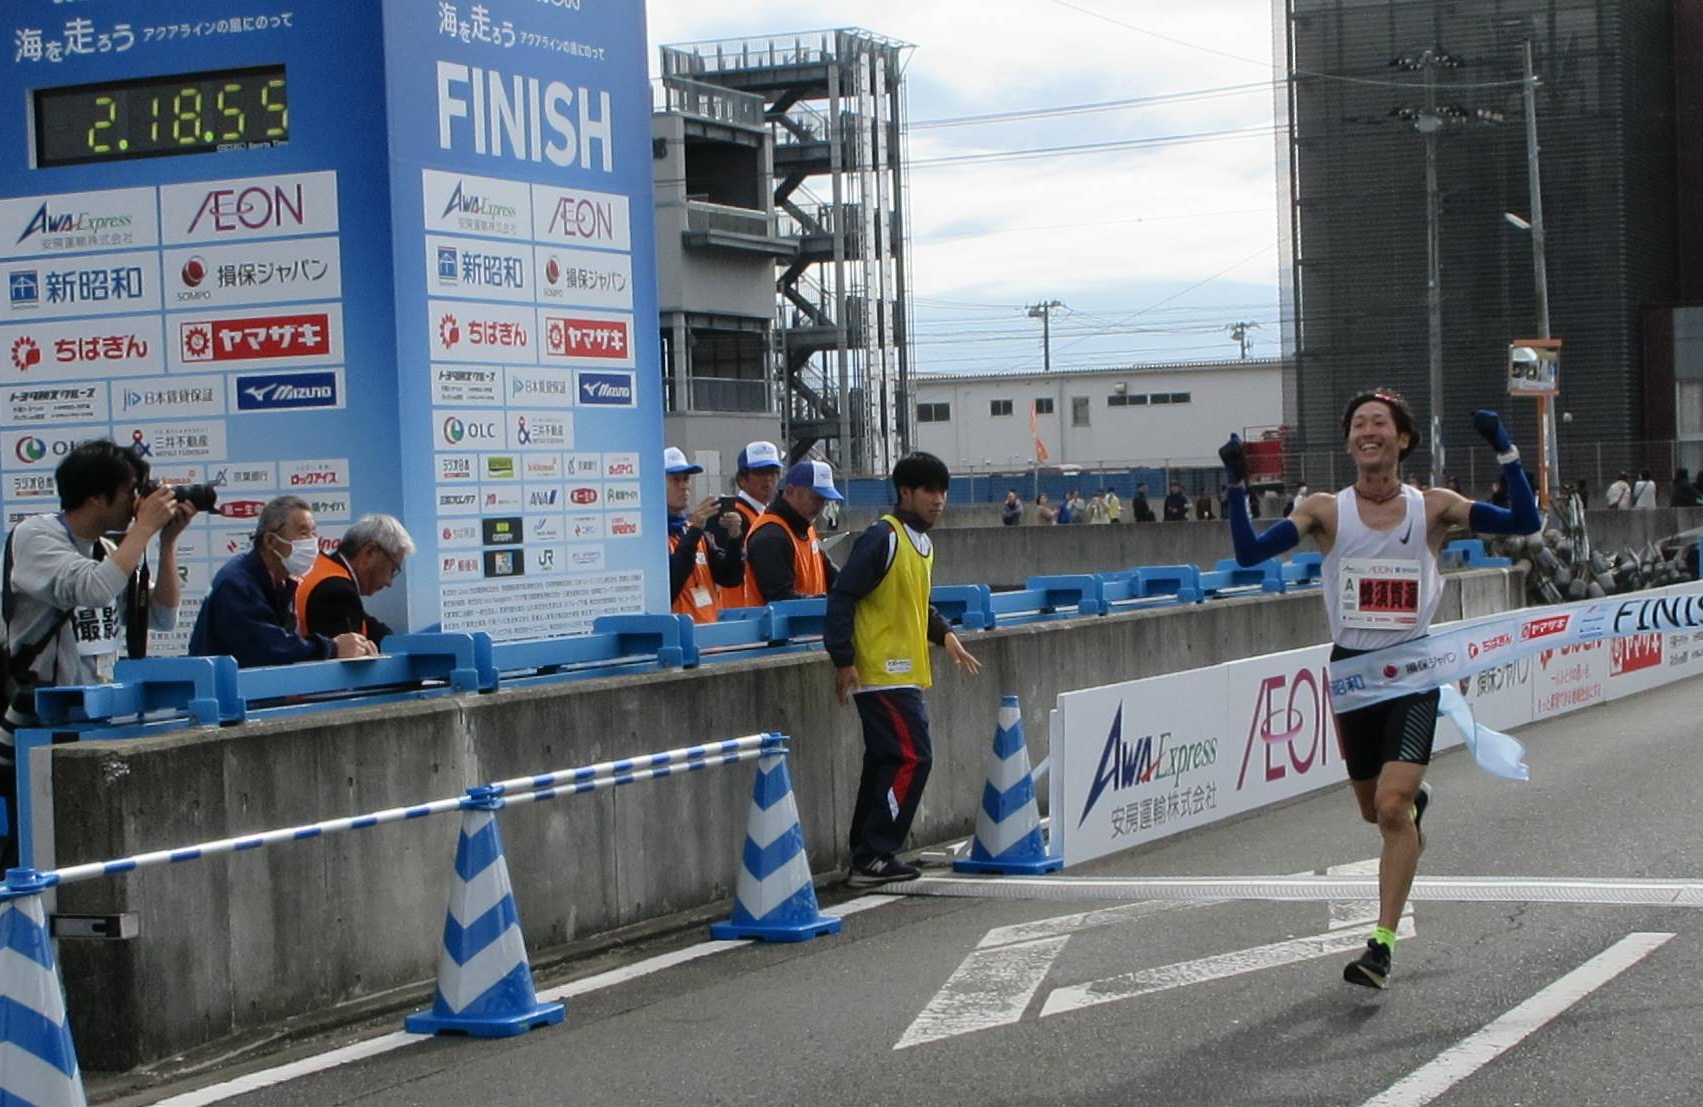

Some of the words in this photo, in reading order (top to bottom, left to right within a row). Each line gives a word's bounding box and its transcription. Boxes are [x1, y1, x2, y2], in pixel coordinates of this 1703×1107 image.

[15, 18, 135, 62] 海を走ろう
[143, 13, 293, 42] アクアラインの風にのって
[438, 1, 516, 48] 海を走ろう
[436, 60, 613, 173] FINISH
[218, 259, 328, 288] 損保ジャパン
[462, 251, 524, 288] 新昭和
[566, 267, 627, 292] 損保ジャパン
[46, 267, 143, 304] 新昭和
[218, 323, 322, 352] ヤマザキ
[467, 320, 528, 347] ちばぎん
[567, 326, 625, 350] ヤマザキ
[54, 334, 148, 362] ちばぎん
[468, 422, 495, 439] OLC
[291, 471, 338, 486] ロックアイス
[530, 491, 549, 506] ANA
[539, 549, 554, 566] JR
[1344, 577, 1355, 592] A
[1532, 617, 1567, 634] ヤマザキ
[1406, 651, 1457, 675] 損保ジャパン
[1154, 732, 1218, 788] Express
[1111, 784, 1218, 839] 安房運輸株式会社
